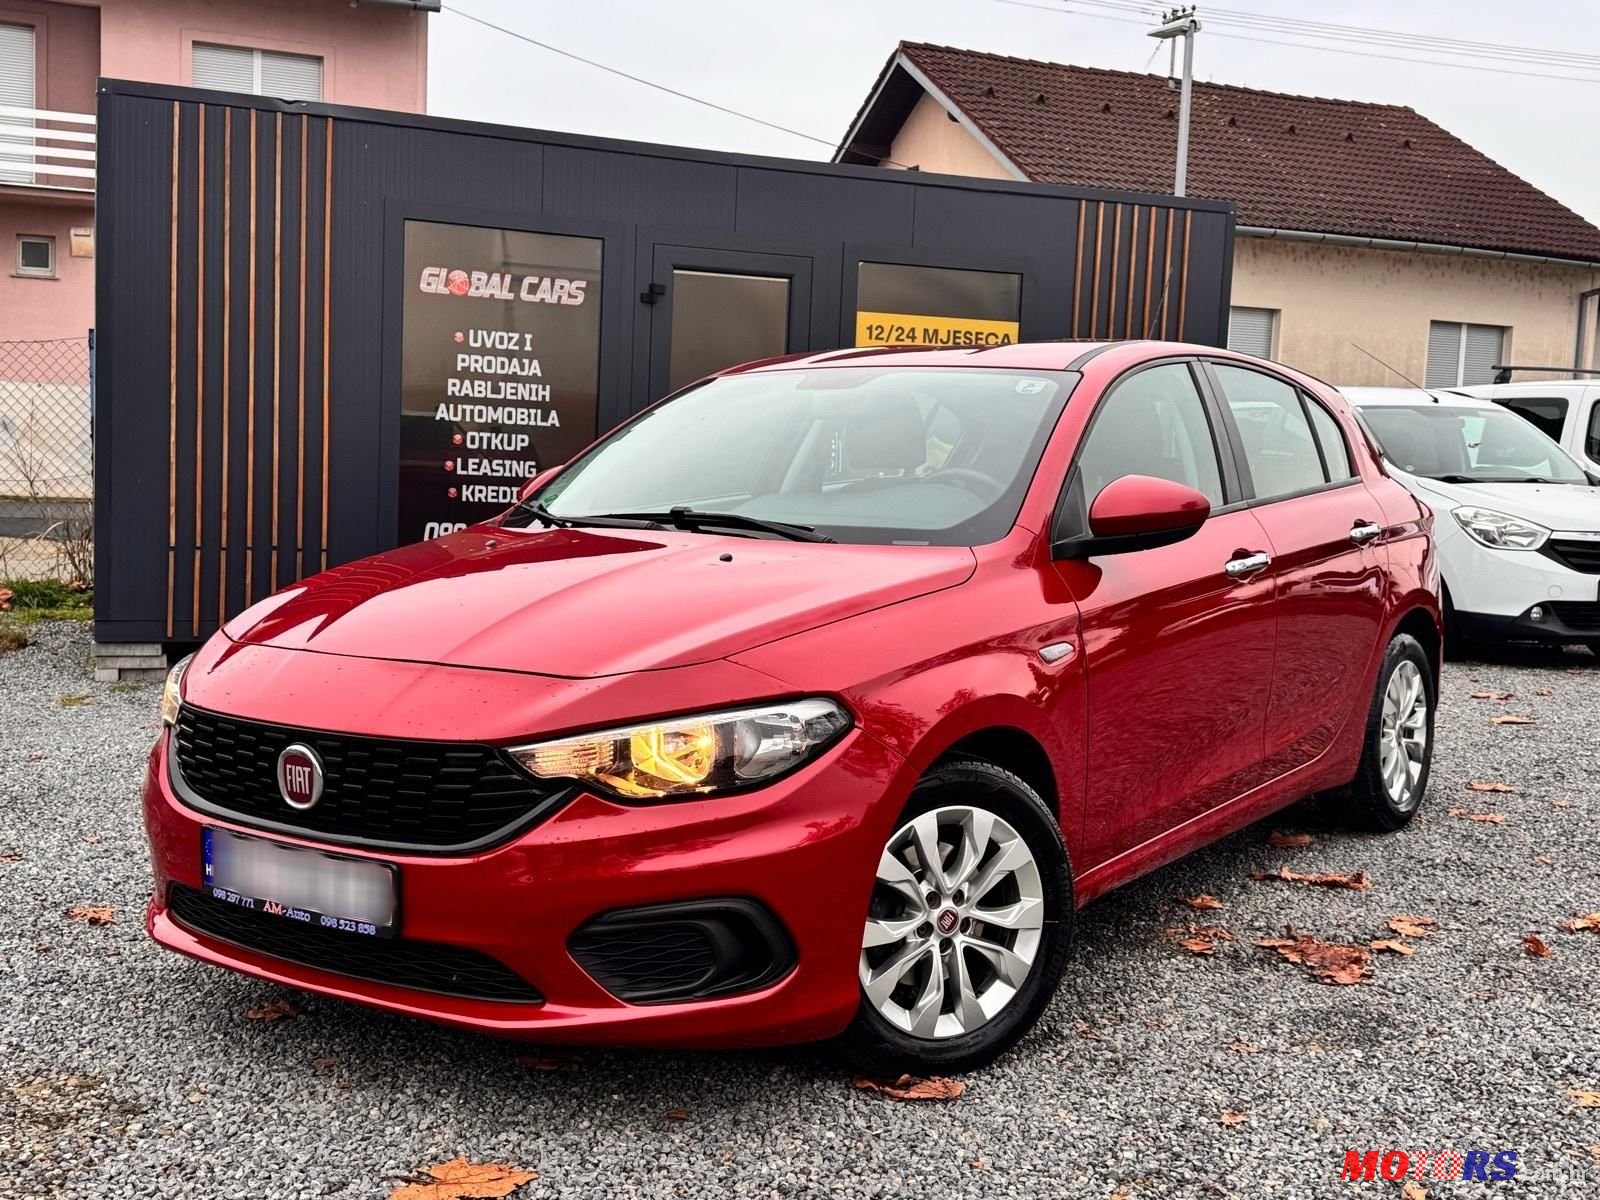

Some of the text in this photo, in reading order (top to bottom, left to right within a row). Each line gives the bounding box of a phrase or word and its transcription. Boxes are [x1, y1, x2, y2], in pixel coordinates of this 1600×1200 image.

[420, 266, 586, 306] GLOBAL CARS
[468, 329, 533, 351] UVOZ I
[866, 324, 1012, 346] 12/24 MJESECA
[456, 353, 542, 377] PRODAJA
[447, 378, 551, 402] RABLJENIH
[435, 402, 560, 428] AUTOMOBILA
[465, 431, 529, 452] OTKUP
[456, 457, 537, 478] LEASING
[461, 484, 520, 504] KREDI
[286, 764, 311, 795] FIAT
[205, 863, 214, 877] H
[263, 899, 311, 922] AM-Auto
